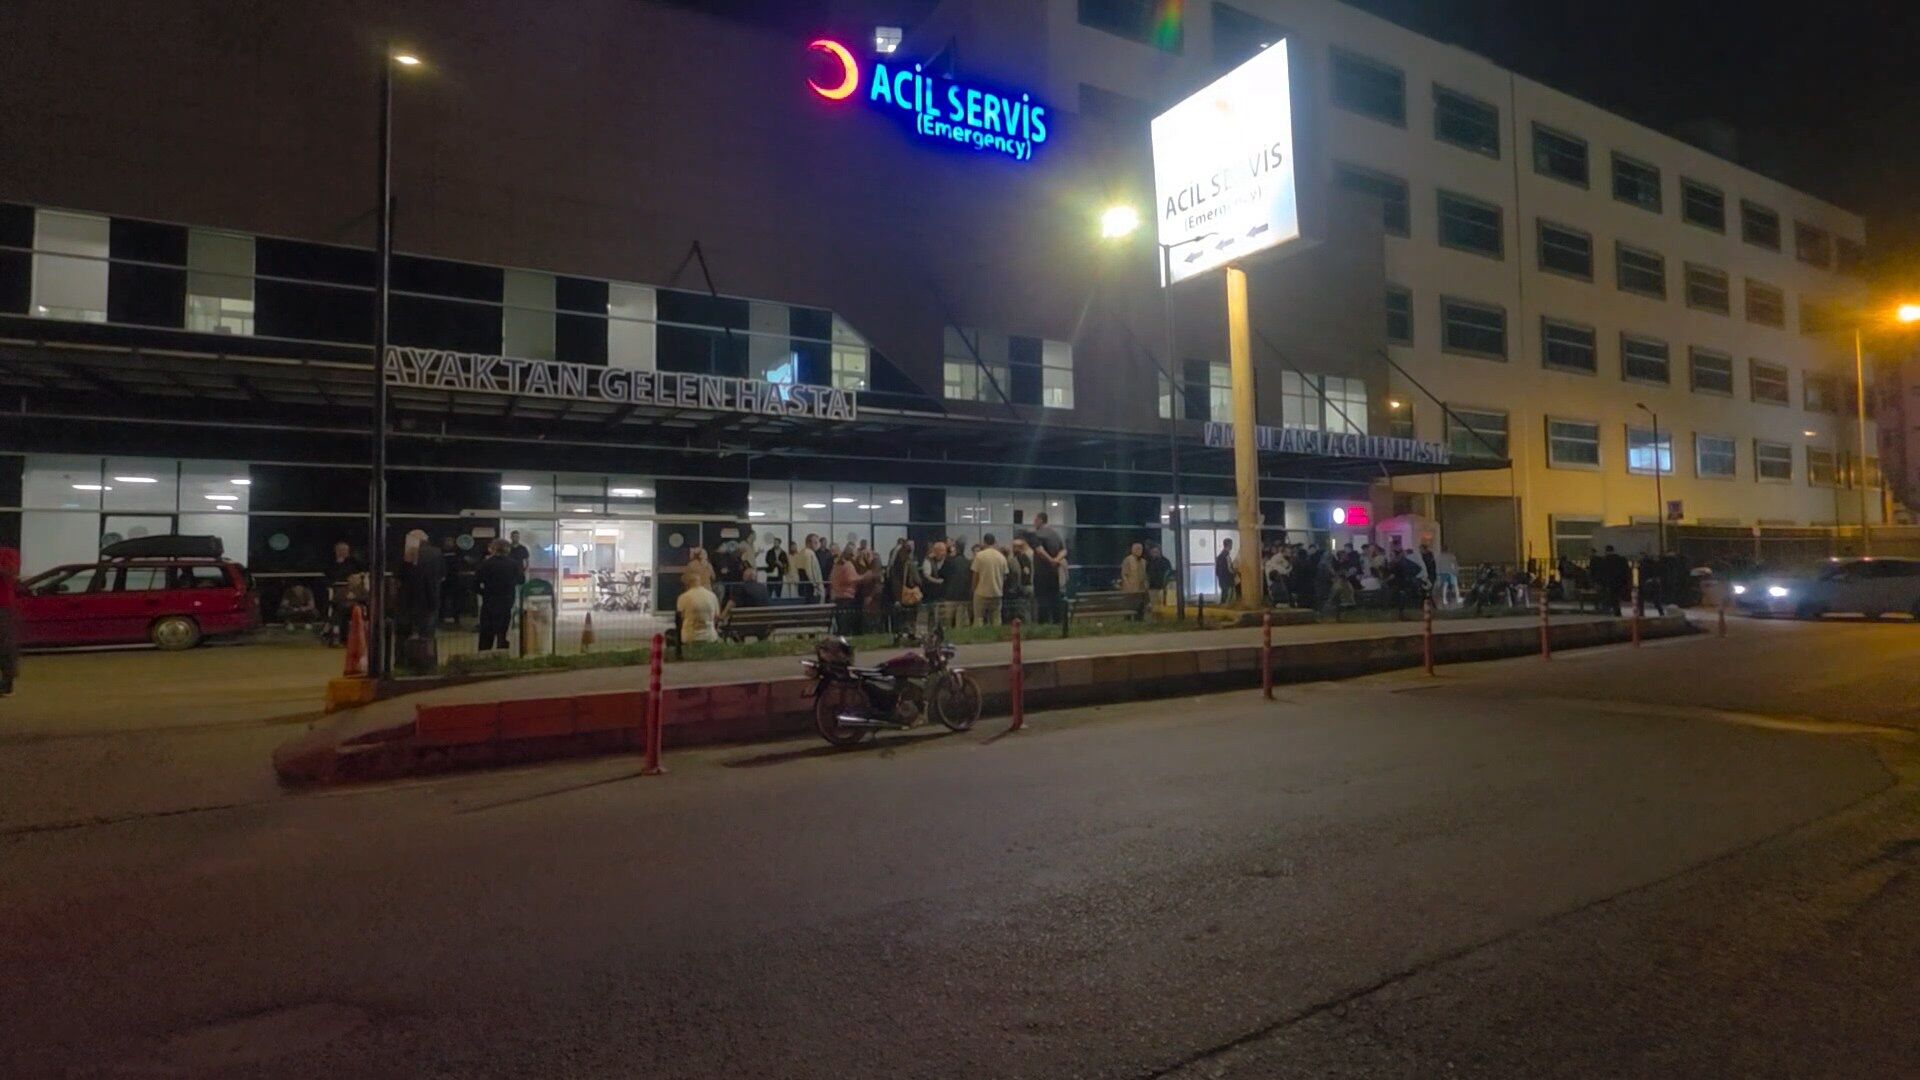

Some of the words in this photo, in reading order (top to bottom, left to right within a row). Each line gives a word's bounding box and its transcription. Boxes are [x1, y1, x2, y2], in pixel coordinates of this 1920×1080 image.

[871, 63, 940, 117] ACİL
[948, 85, 1047, 142] SERVİS
[917, 112, 1031, 160] (Emergency)
[1211, 142, 1283, 197] SEVİS
[384, 346, 589, 400] AYAKTAN
[599, 367, 724, 412] GELEN
[737, 380, 850, 420] HASTA
